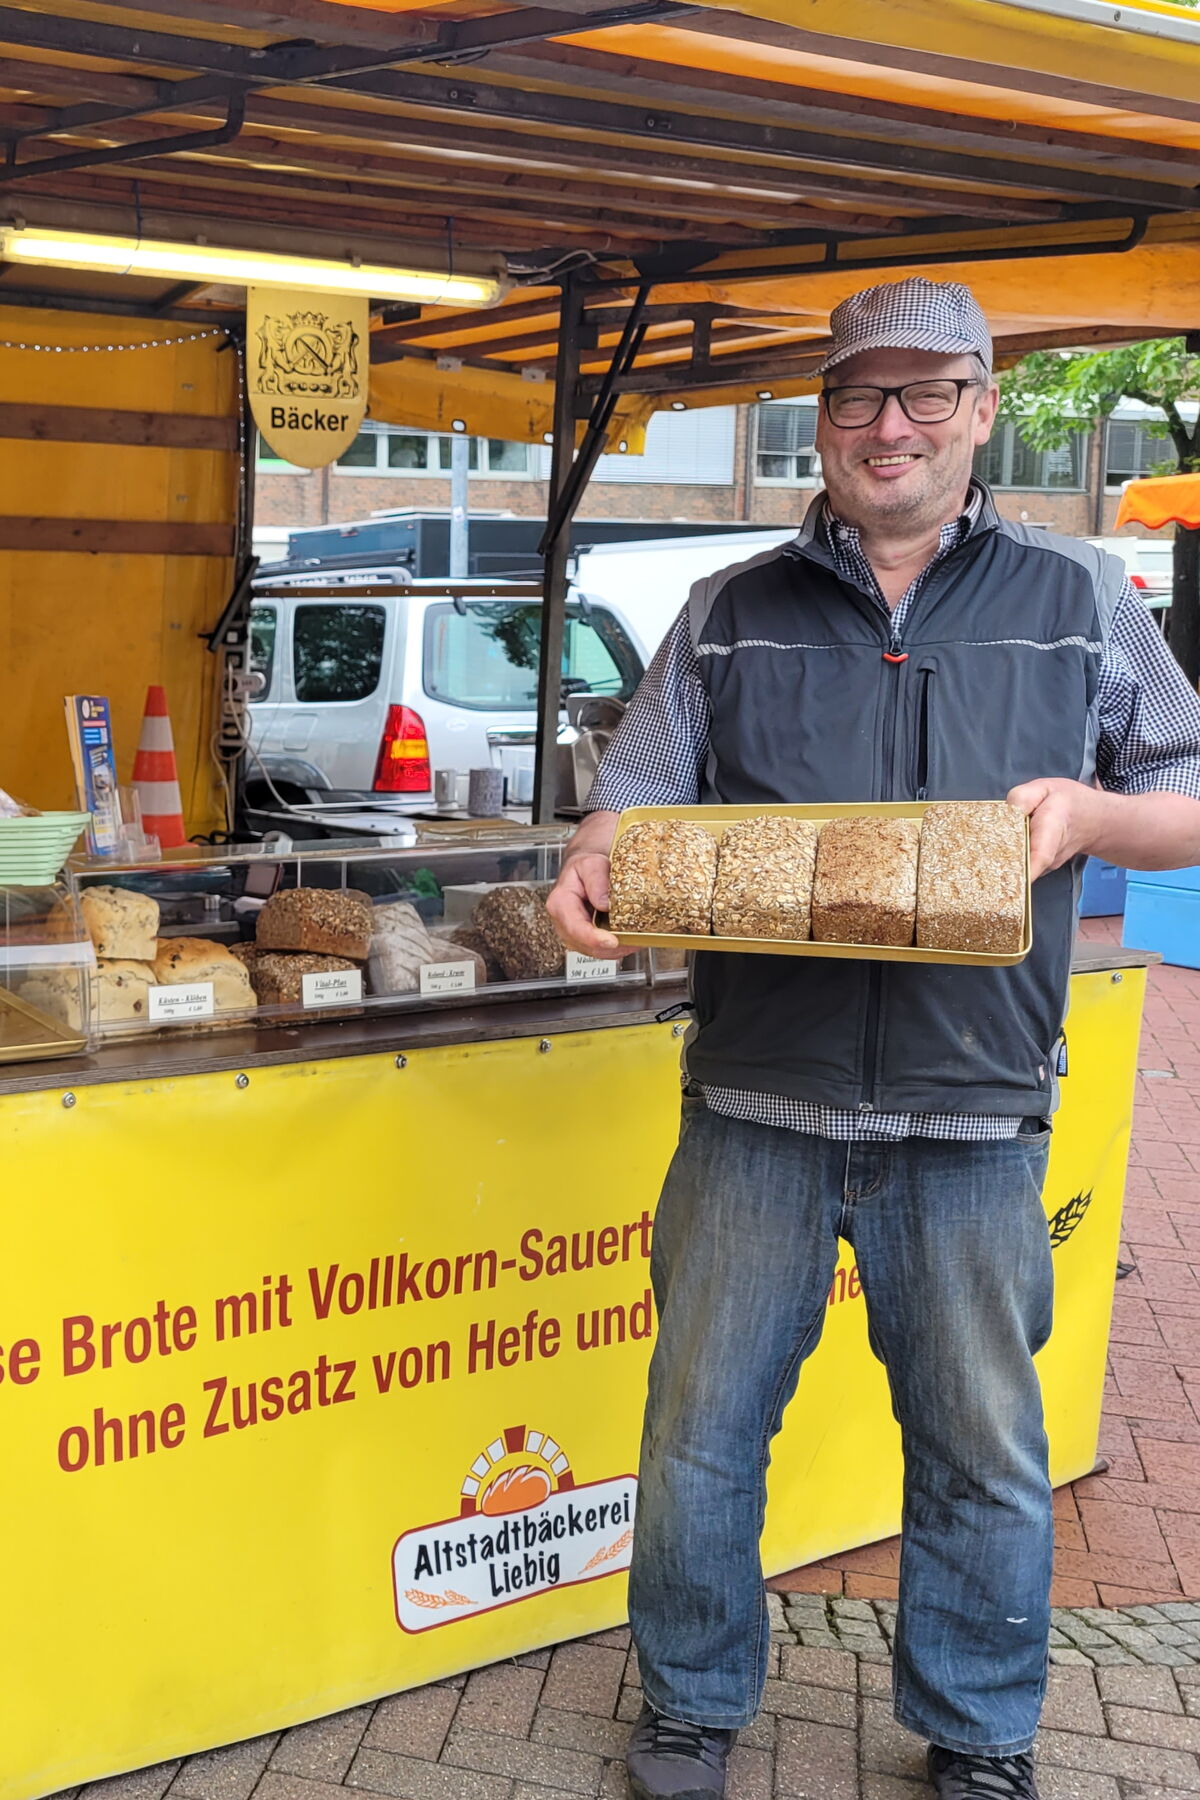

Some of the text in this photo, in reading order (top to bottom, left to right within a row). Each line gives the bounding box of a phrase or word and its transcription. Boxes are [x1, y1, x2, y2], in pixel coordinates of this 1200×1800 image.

[271, 406, 349, 432] Bäcker
[62, 1299, 197, 1377] Brote
[215, 1274, 293, 1342] mit
[57, 1402, 186, 1473] ohne
[202, 1354, 357, 1439] Zusatz
[372, 1340, 450, 1394] von
[468, 1309, 561, 1375] Hefe
[576, 1288, 652, 1351] und
[414, 1492, 630, 1580] Altstadtbäckerei
[489, 1552, 560, 1597] Liebig
